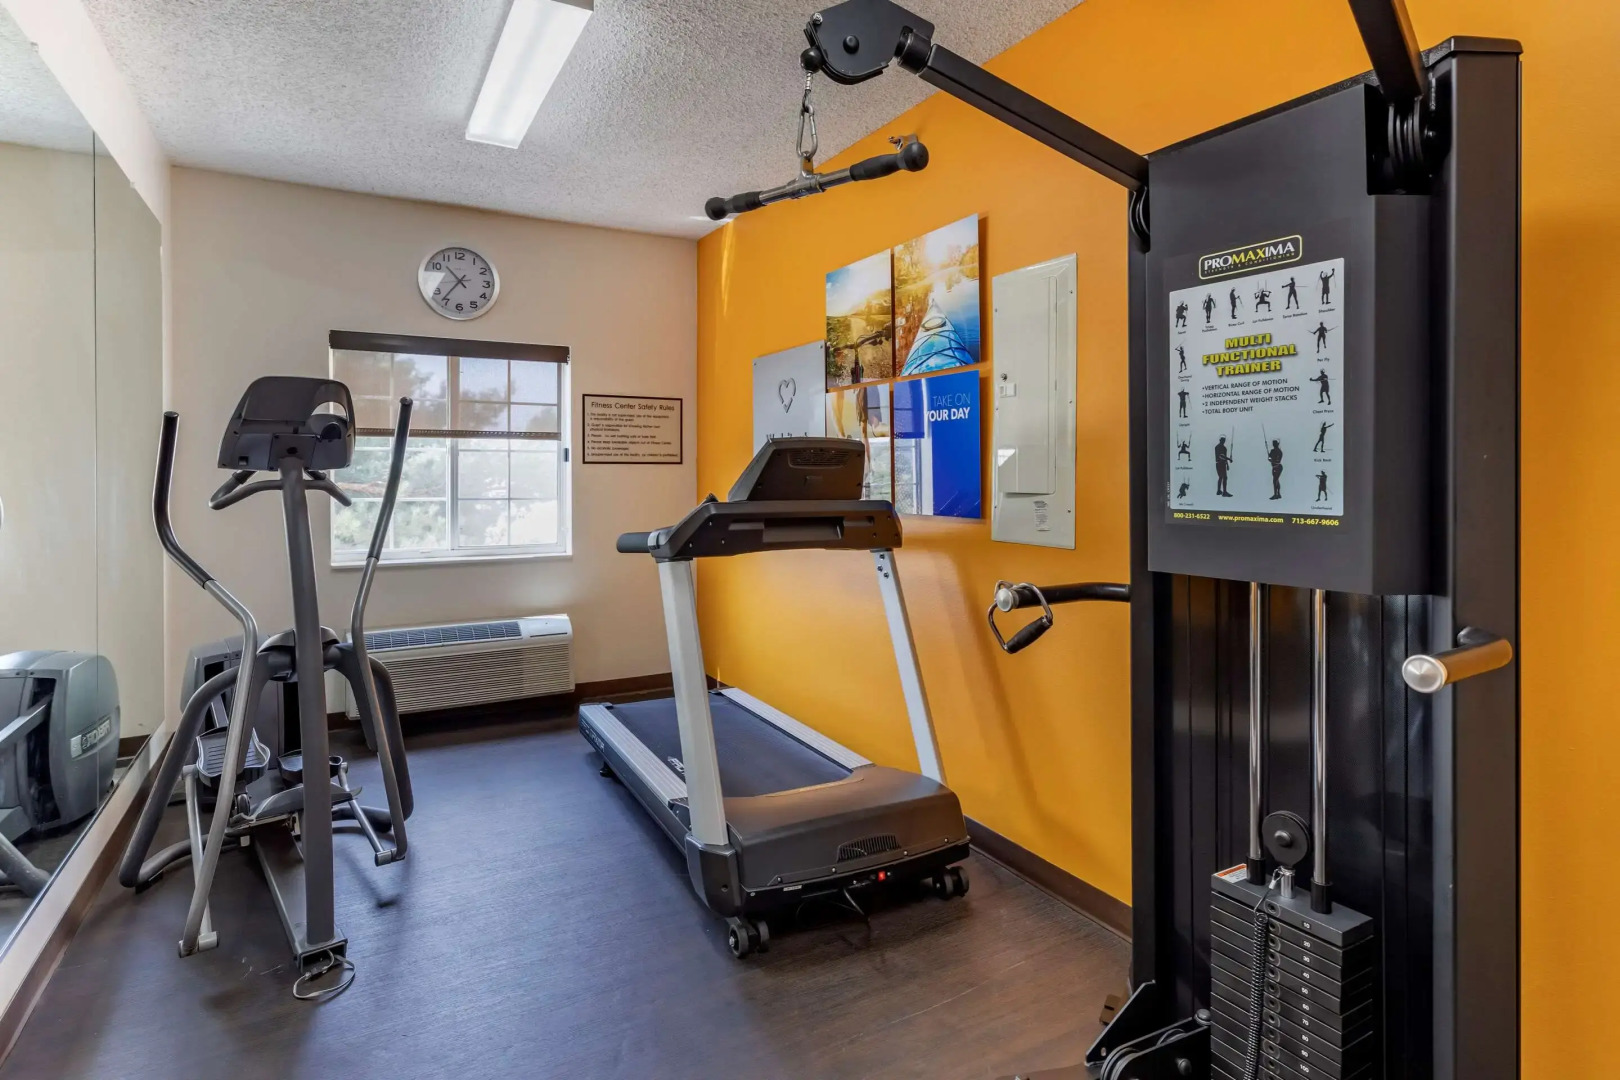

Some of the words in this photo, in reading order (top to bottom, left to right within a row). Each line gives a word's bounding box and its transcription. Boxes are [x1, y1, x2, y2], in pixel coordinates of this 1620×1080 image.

[443, 254, 450, 262] 11
[455, 252, 465, 260] 12
[1204, 242, 1295, 270] PROMAXIMA
[432, 262, 442, 270] 10
[470, 301, 478, 309] 5
[1225, 333, 1271, 348] MULTI
[1202, 344, 1297, 364] FUNCTIONAL
[1216, 360, 1281, 376] TRAINER
[1262, 378, 1288, 386] MOTION
[1205, 391, 1240, 399] HORIZONTAL
[1250, 396, 1273, 404] WEIGHT
[1275, 394, 1297, 402] STACKS
[932, 394, 953, 407] TAKE
[955, 392, 971, 406] ON
[638, 403, 657, 411] Safety
[923, 409, 949, 422] YOUR
[951, 406, 970, 420] DAY
[1173, 512, 1210, 520] 800-231-6522
[1218, 515, 1284, 524] www.promaxima.com
[1291, 517, 1339, 526] 713-667-9606
[1301, 987, 1308, 995] 50
[1300, 1065, 1309, 1073] 100
